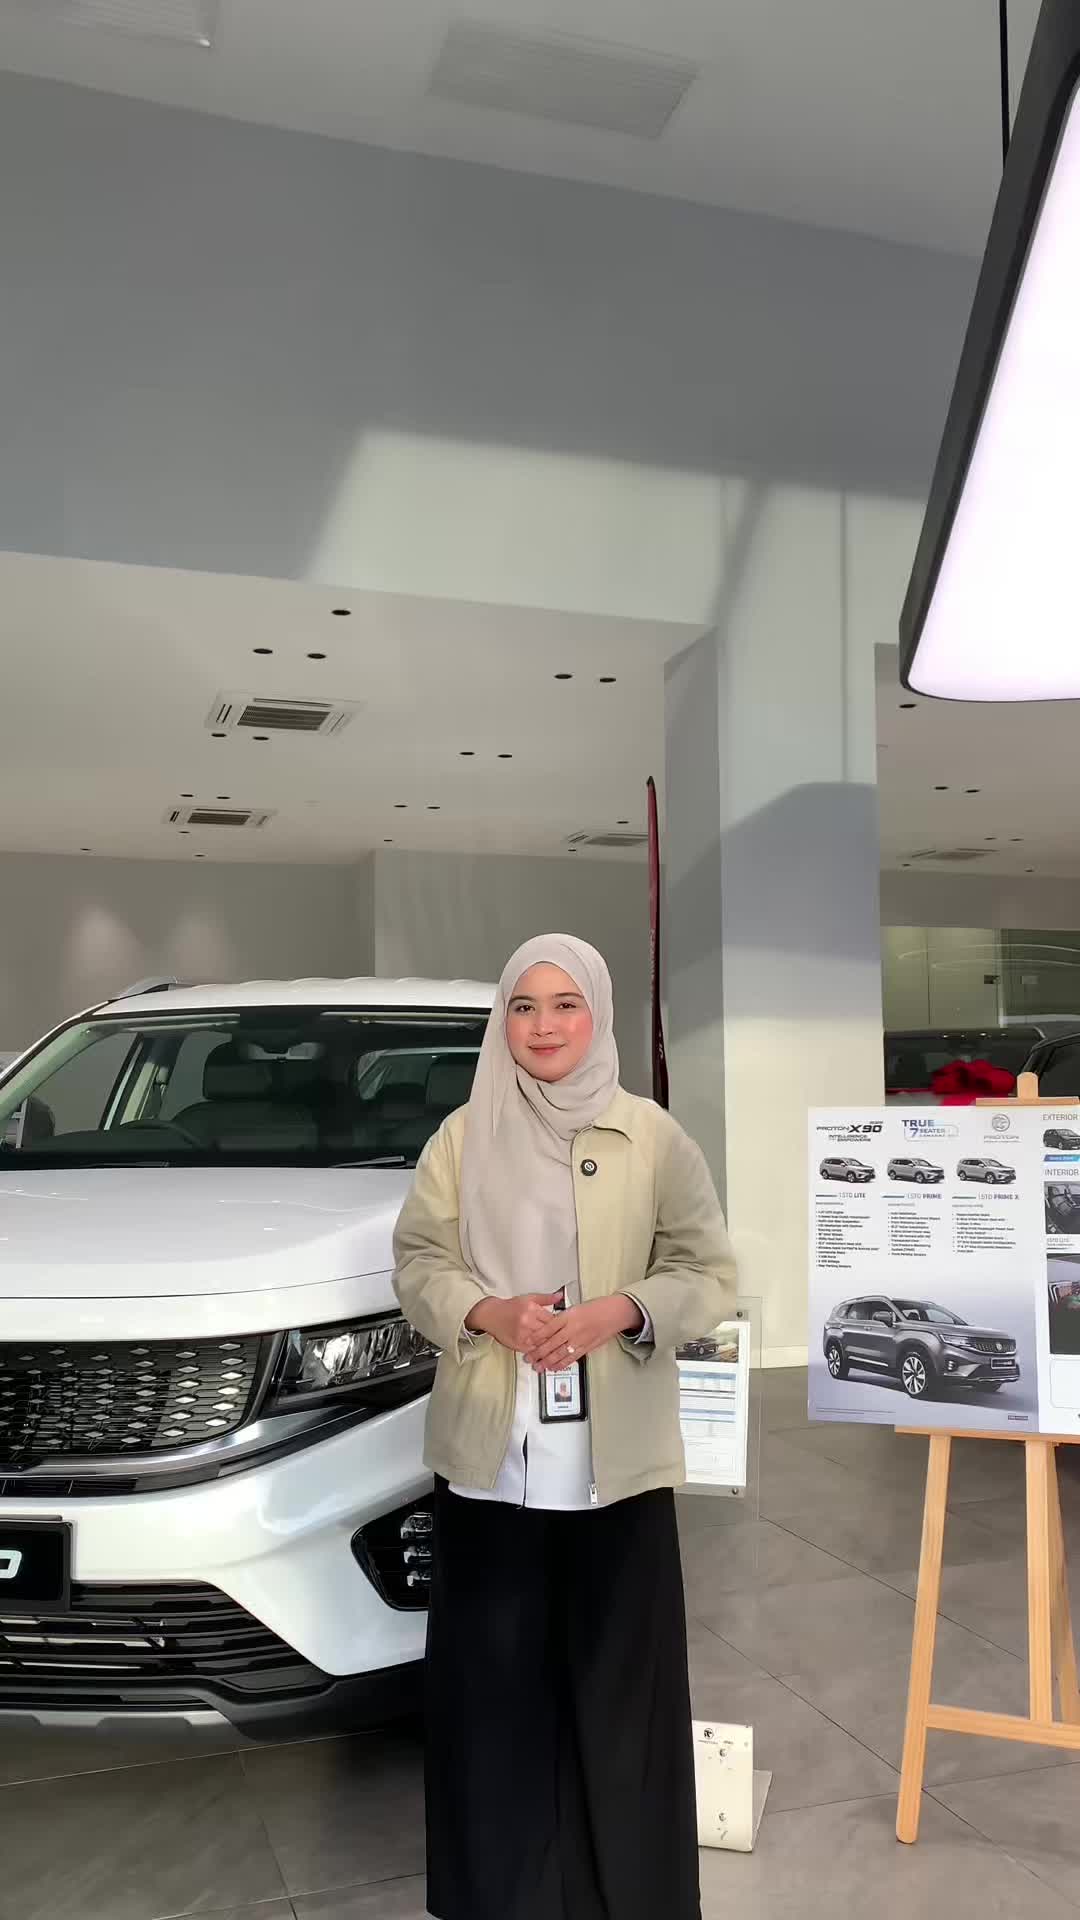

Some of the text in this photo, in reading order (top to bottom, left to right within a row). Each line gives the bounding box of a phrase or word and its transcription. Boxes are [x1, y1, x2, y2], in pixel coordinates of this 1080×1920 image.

[1043, 1113, 1078, 1121] EXTERIOR
[901, 1119, 935, 1127] TRUE
[848, 1124, 882, 1133] X90
[909, 1127, 919, 1138] 7
[1044, 1168, 1079, 1177] INTERIOR
